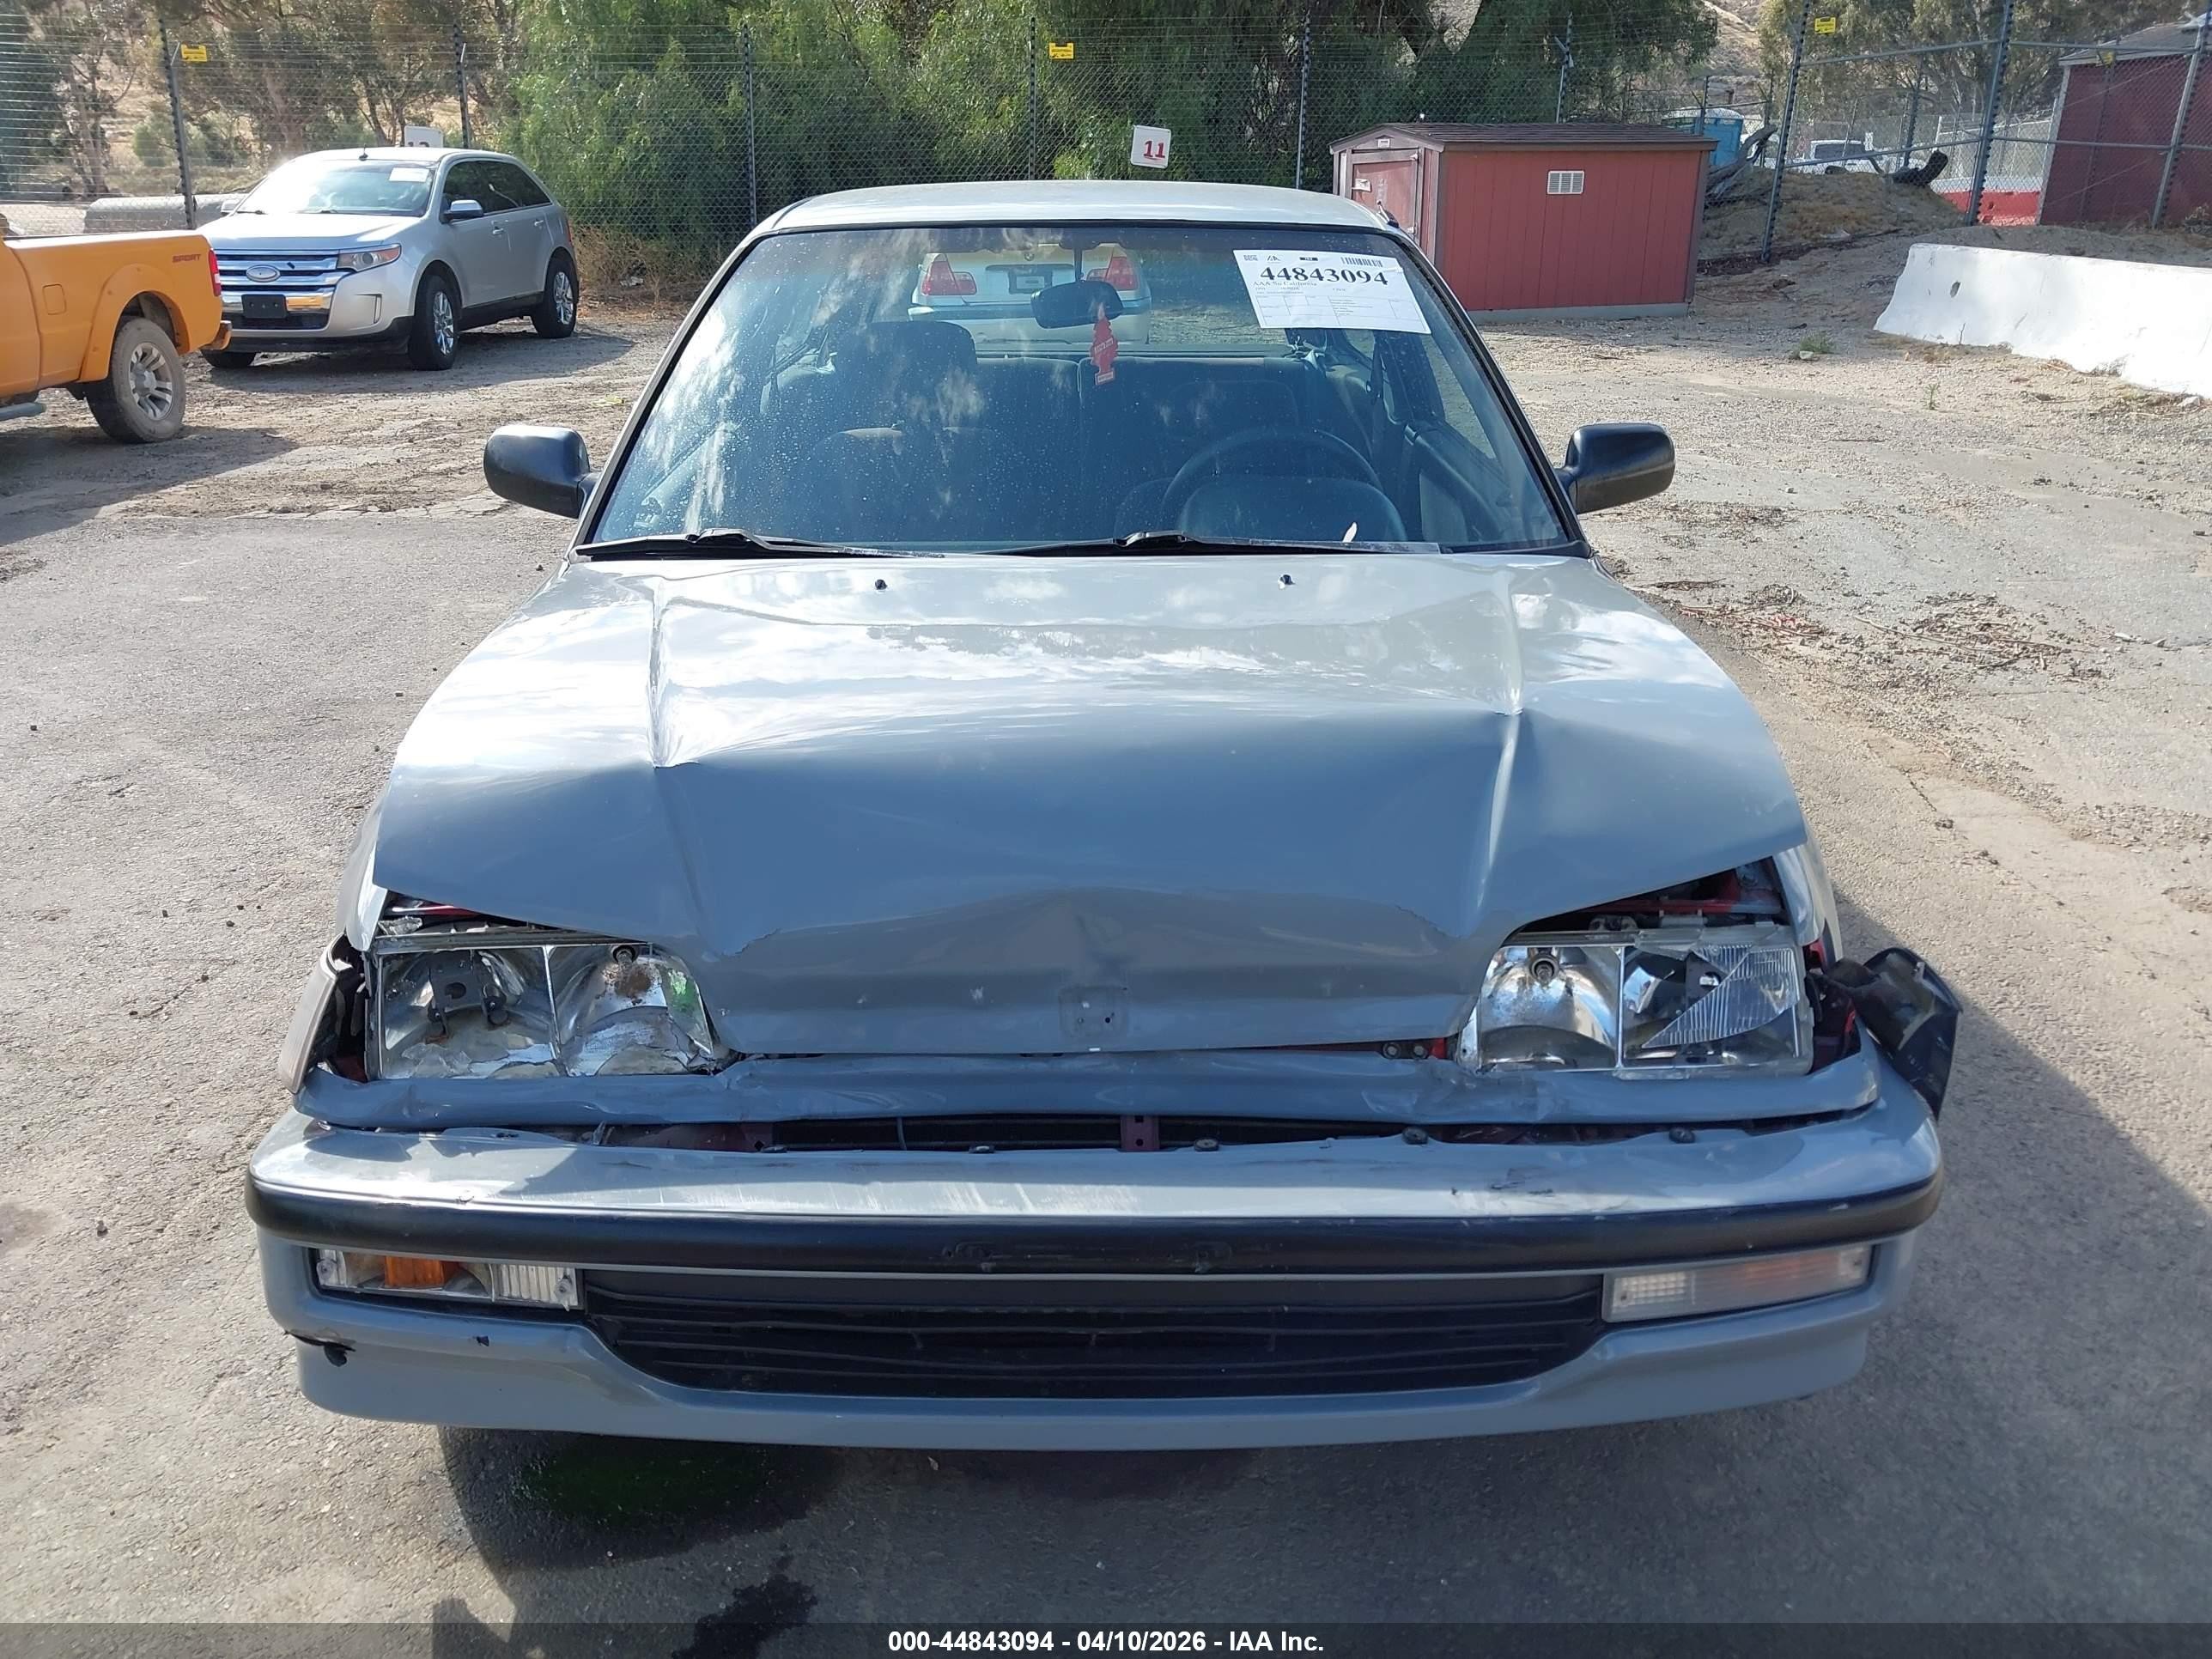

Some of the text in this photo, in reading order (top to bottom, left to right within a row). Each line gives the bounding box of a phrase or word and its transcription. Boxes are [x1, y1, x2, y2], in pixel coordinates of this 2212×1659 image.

[1144, 140, 1165, 159] 11
[173, 253, 202, 263] SPORT
[1260, 266, 1389, 286] 44843094
